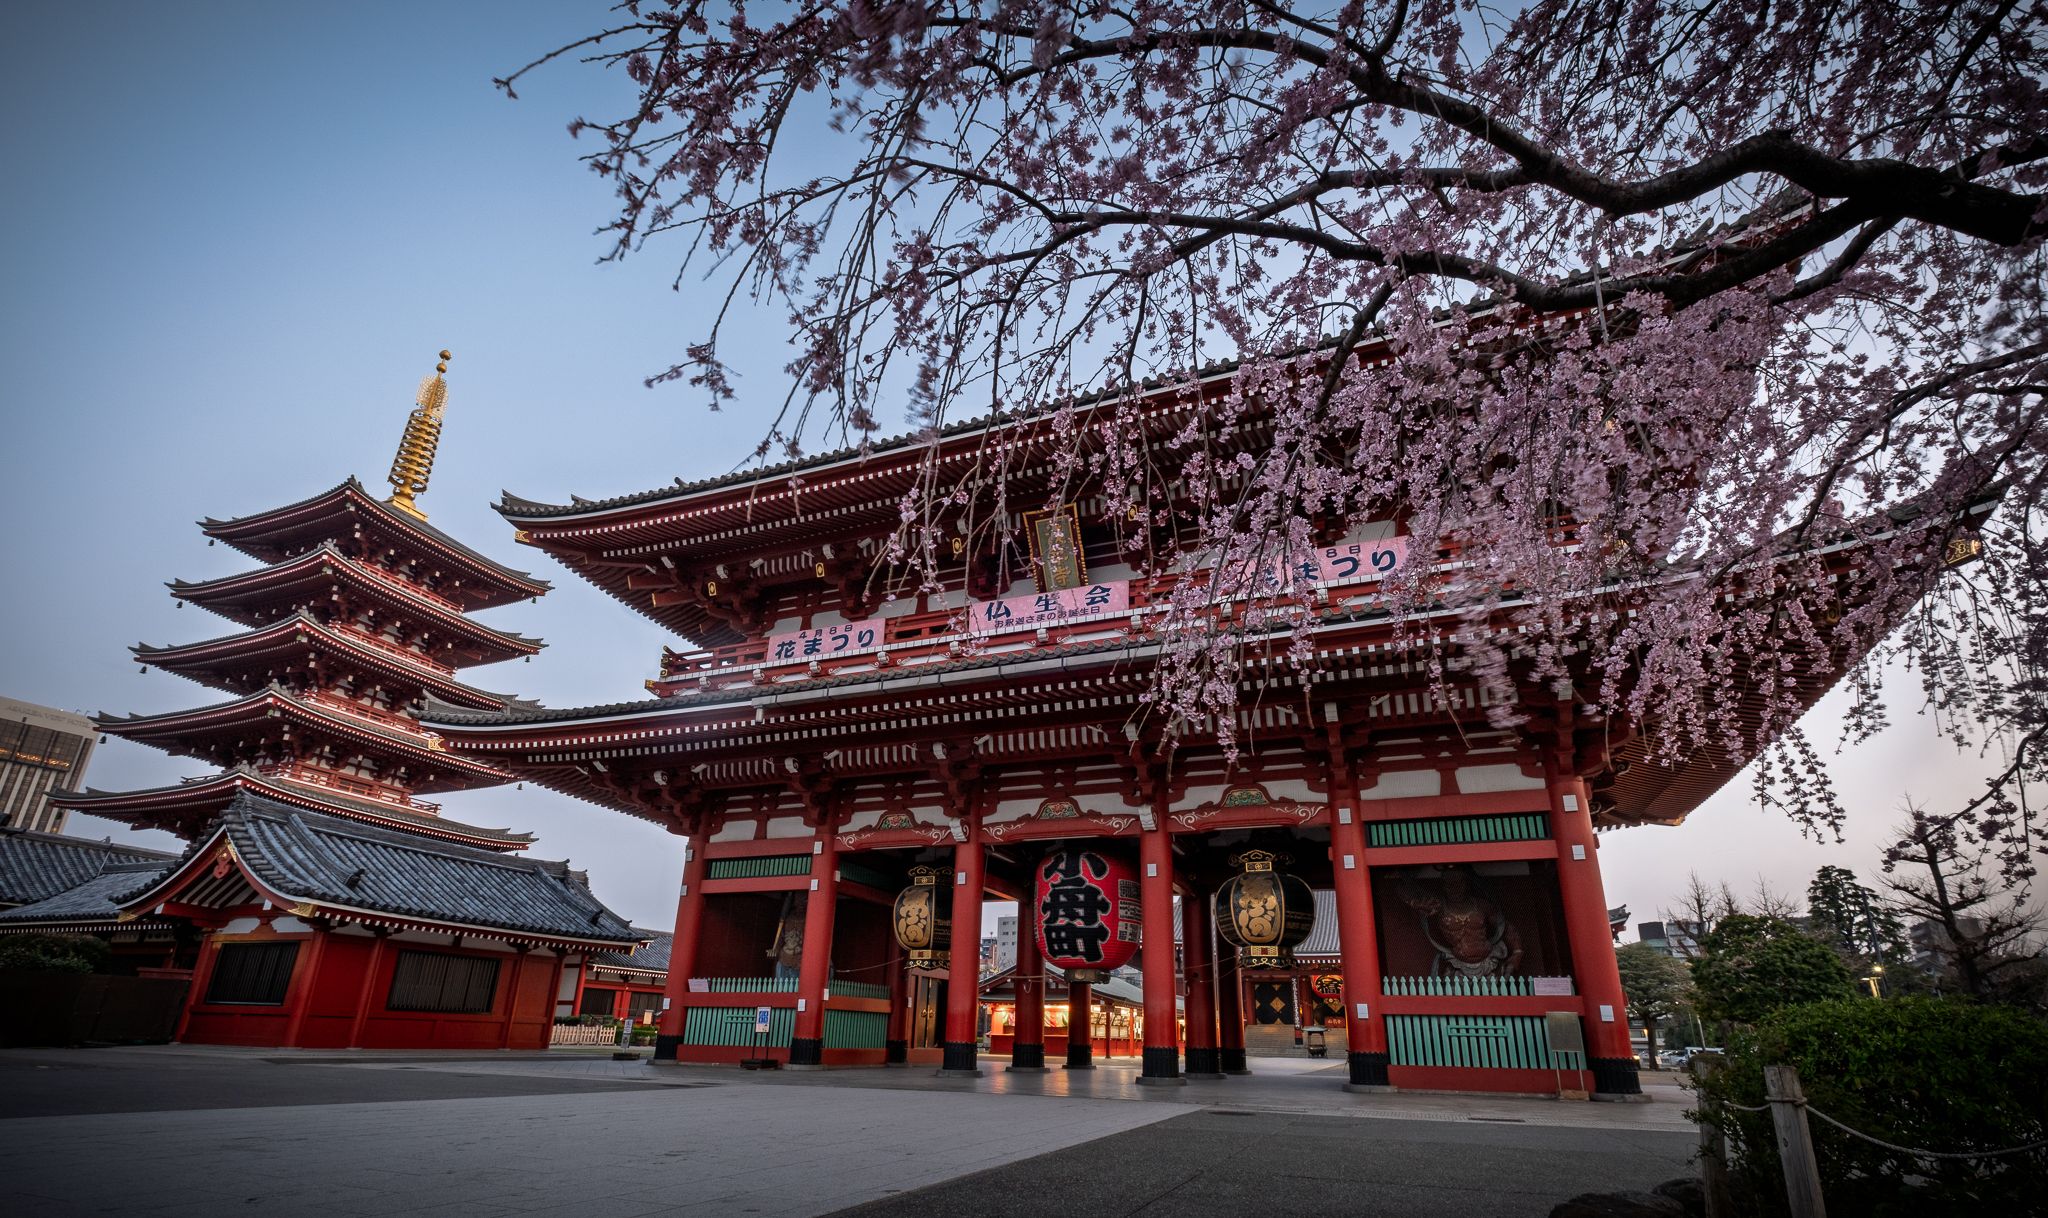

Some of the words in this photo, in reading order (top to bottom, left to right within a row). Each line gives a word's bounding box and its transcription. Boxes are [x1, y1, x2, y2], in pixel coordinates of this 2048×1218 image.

[1251, 550, 1396, 587] まつり
[985, 585, 1112, 621] 仏生会
[775, 629, 874, 660] 花まつり
[799, 624, 853, 639] 4月8日
[1042, 851, 1112, 963] 小舟町
